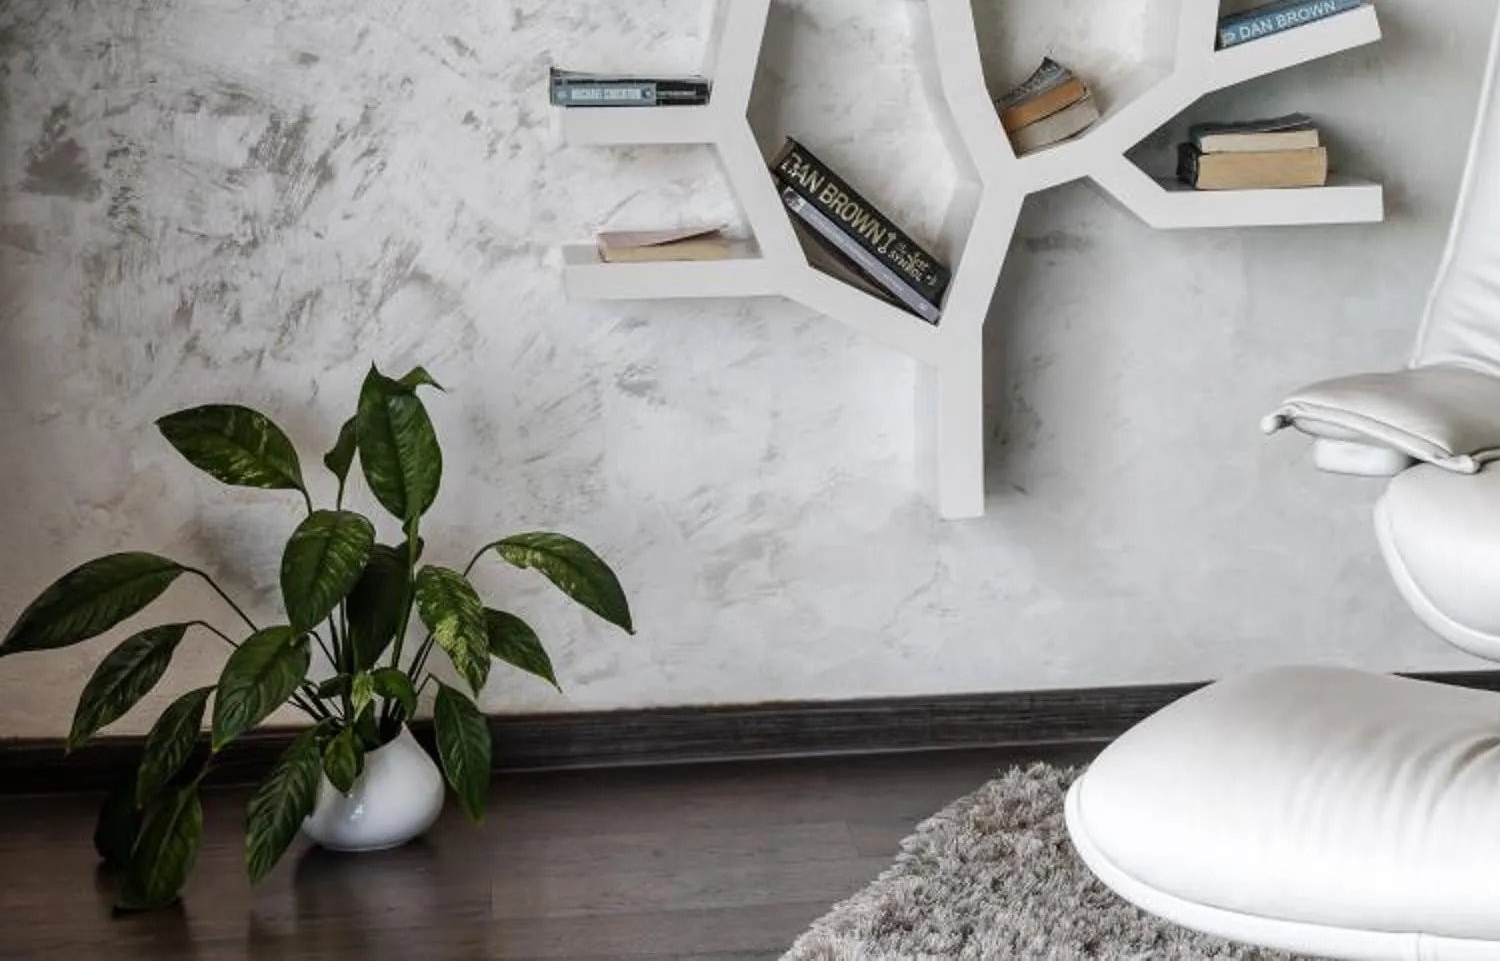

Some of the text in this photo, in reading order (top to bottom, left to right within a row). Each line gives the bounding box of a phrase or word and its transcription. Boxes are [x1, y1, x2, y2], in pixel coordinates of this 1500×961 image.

[1239, 18, 1273, 40] DAN
[1275, 0, 1337, 29] BROWN
[780, 152, 887, 245] DAN BROWN
